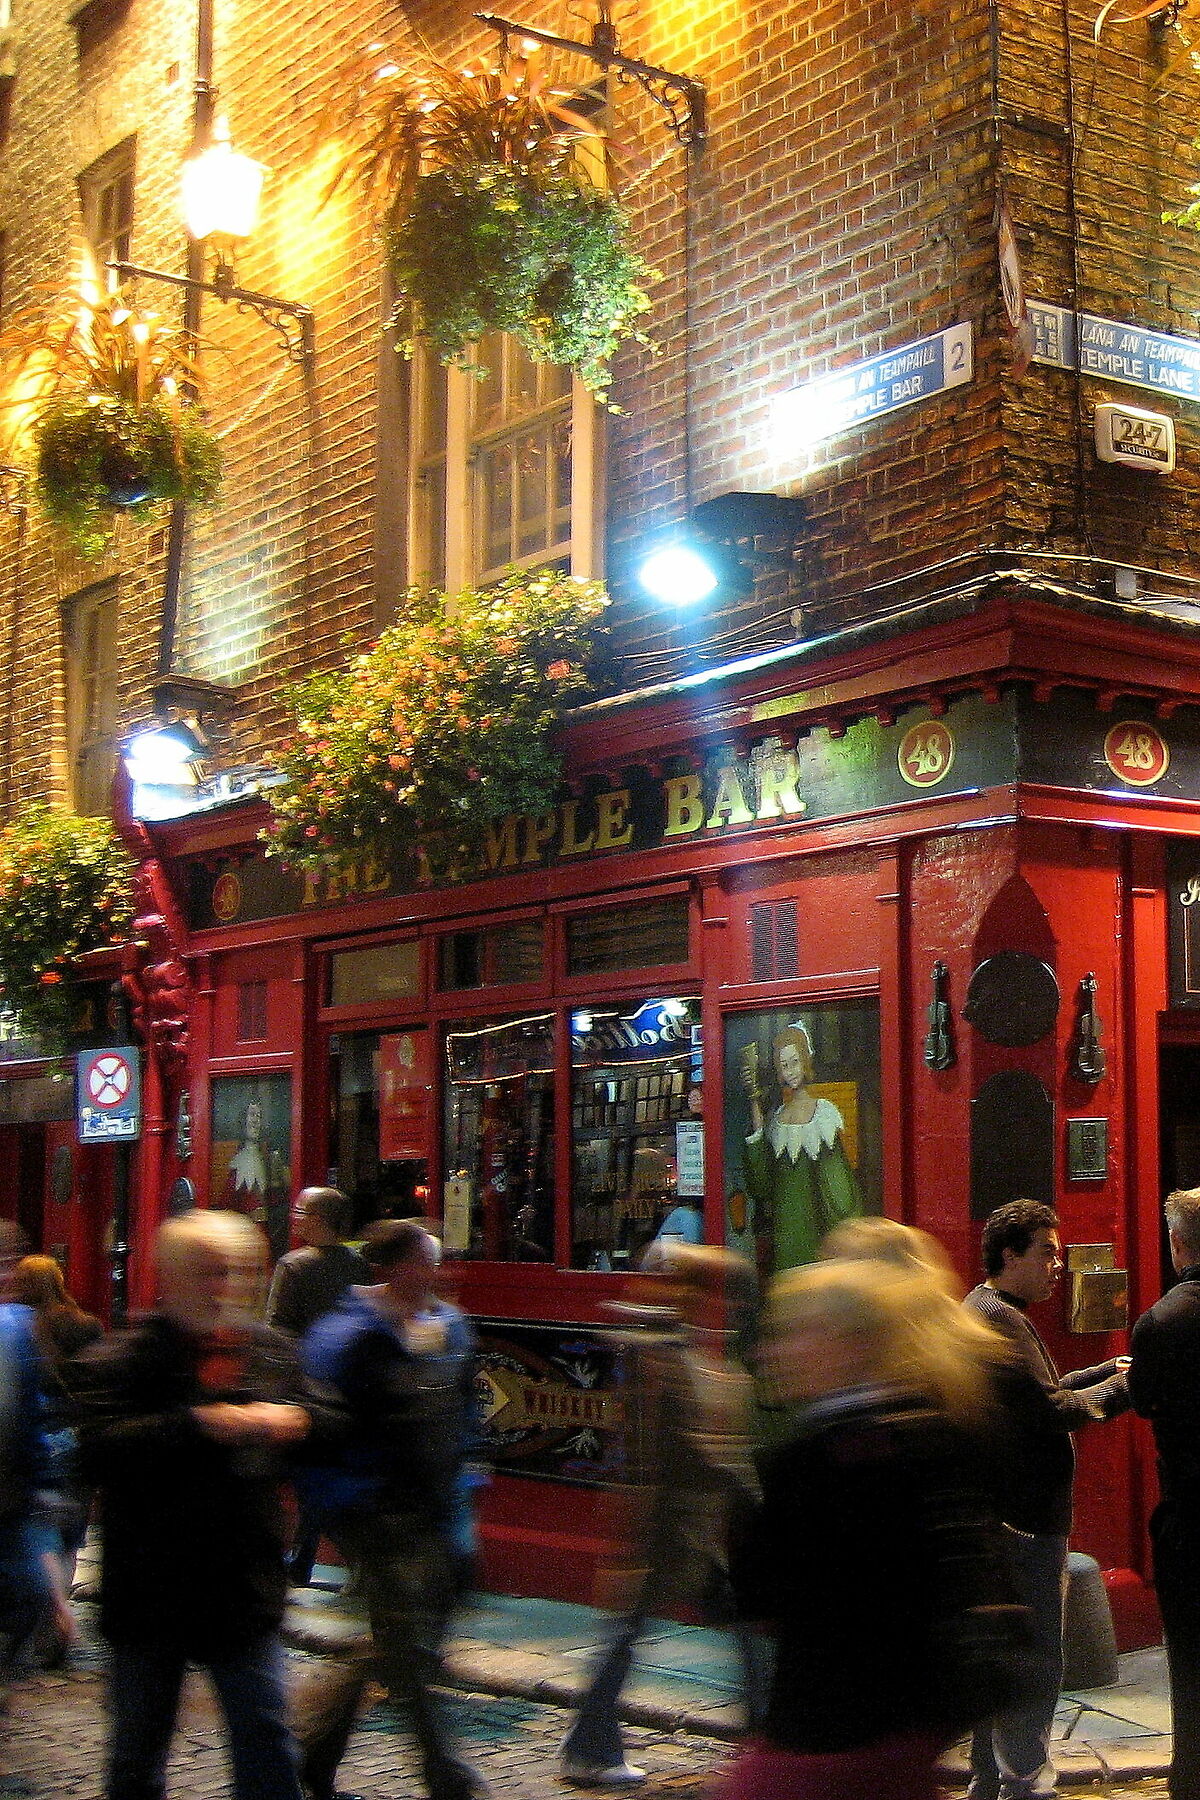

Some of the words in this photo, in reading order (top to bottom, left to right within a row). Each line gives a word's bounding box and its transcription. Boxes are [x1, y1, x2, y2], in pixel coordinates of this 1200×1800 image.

[951, 341, 966, 372] 2
[1118, 333, 1140, 353] AN
[1081, 347, 1145, 379] TEMPLE
[1148, 363, 1194, 392] LANE
[891, 374, 923, 402] BAR
[906, 734, 943, 776] 48
[1115, 733, 1155, 769] 48
[664, 752, 807, 836] BAR
